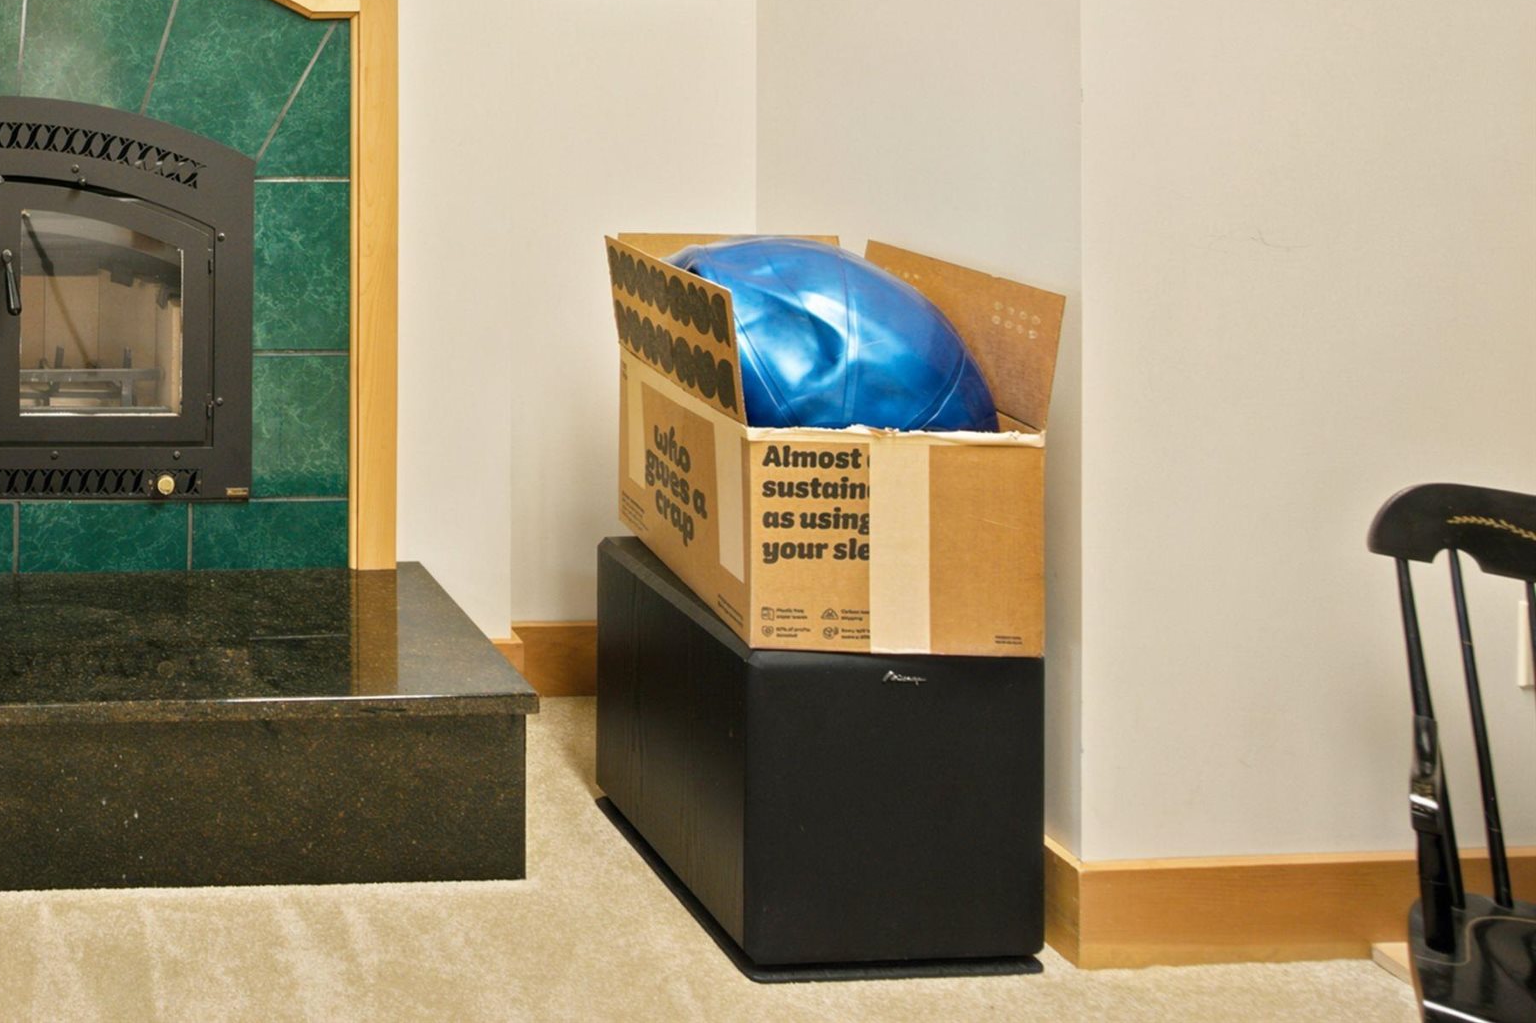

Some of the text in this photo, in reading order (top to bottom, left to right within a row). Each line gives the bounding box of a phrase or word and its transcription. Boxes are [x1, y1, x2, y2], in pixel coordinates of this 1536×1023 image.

[654, 424, 692, 474] who
[762, 444, 863, 470] Almost
[645, 448, 691, 506] gives
[692, 488, 708, 520] a
[762, 476, 870, 499] sustain
[655, 488, 695, 548] crap
[762, 506, 870, 536] as using
[762, 537, 870, 565] your sle
